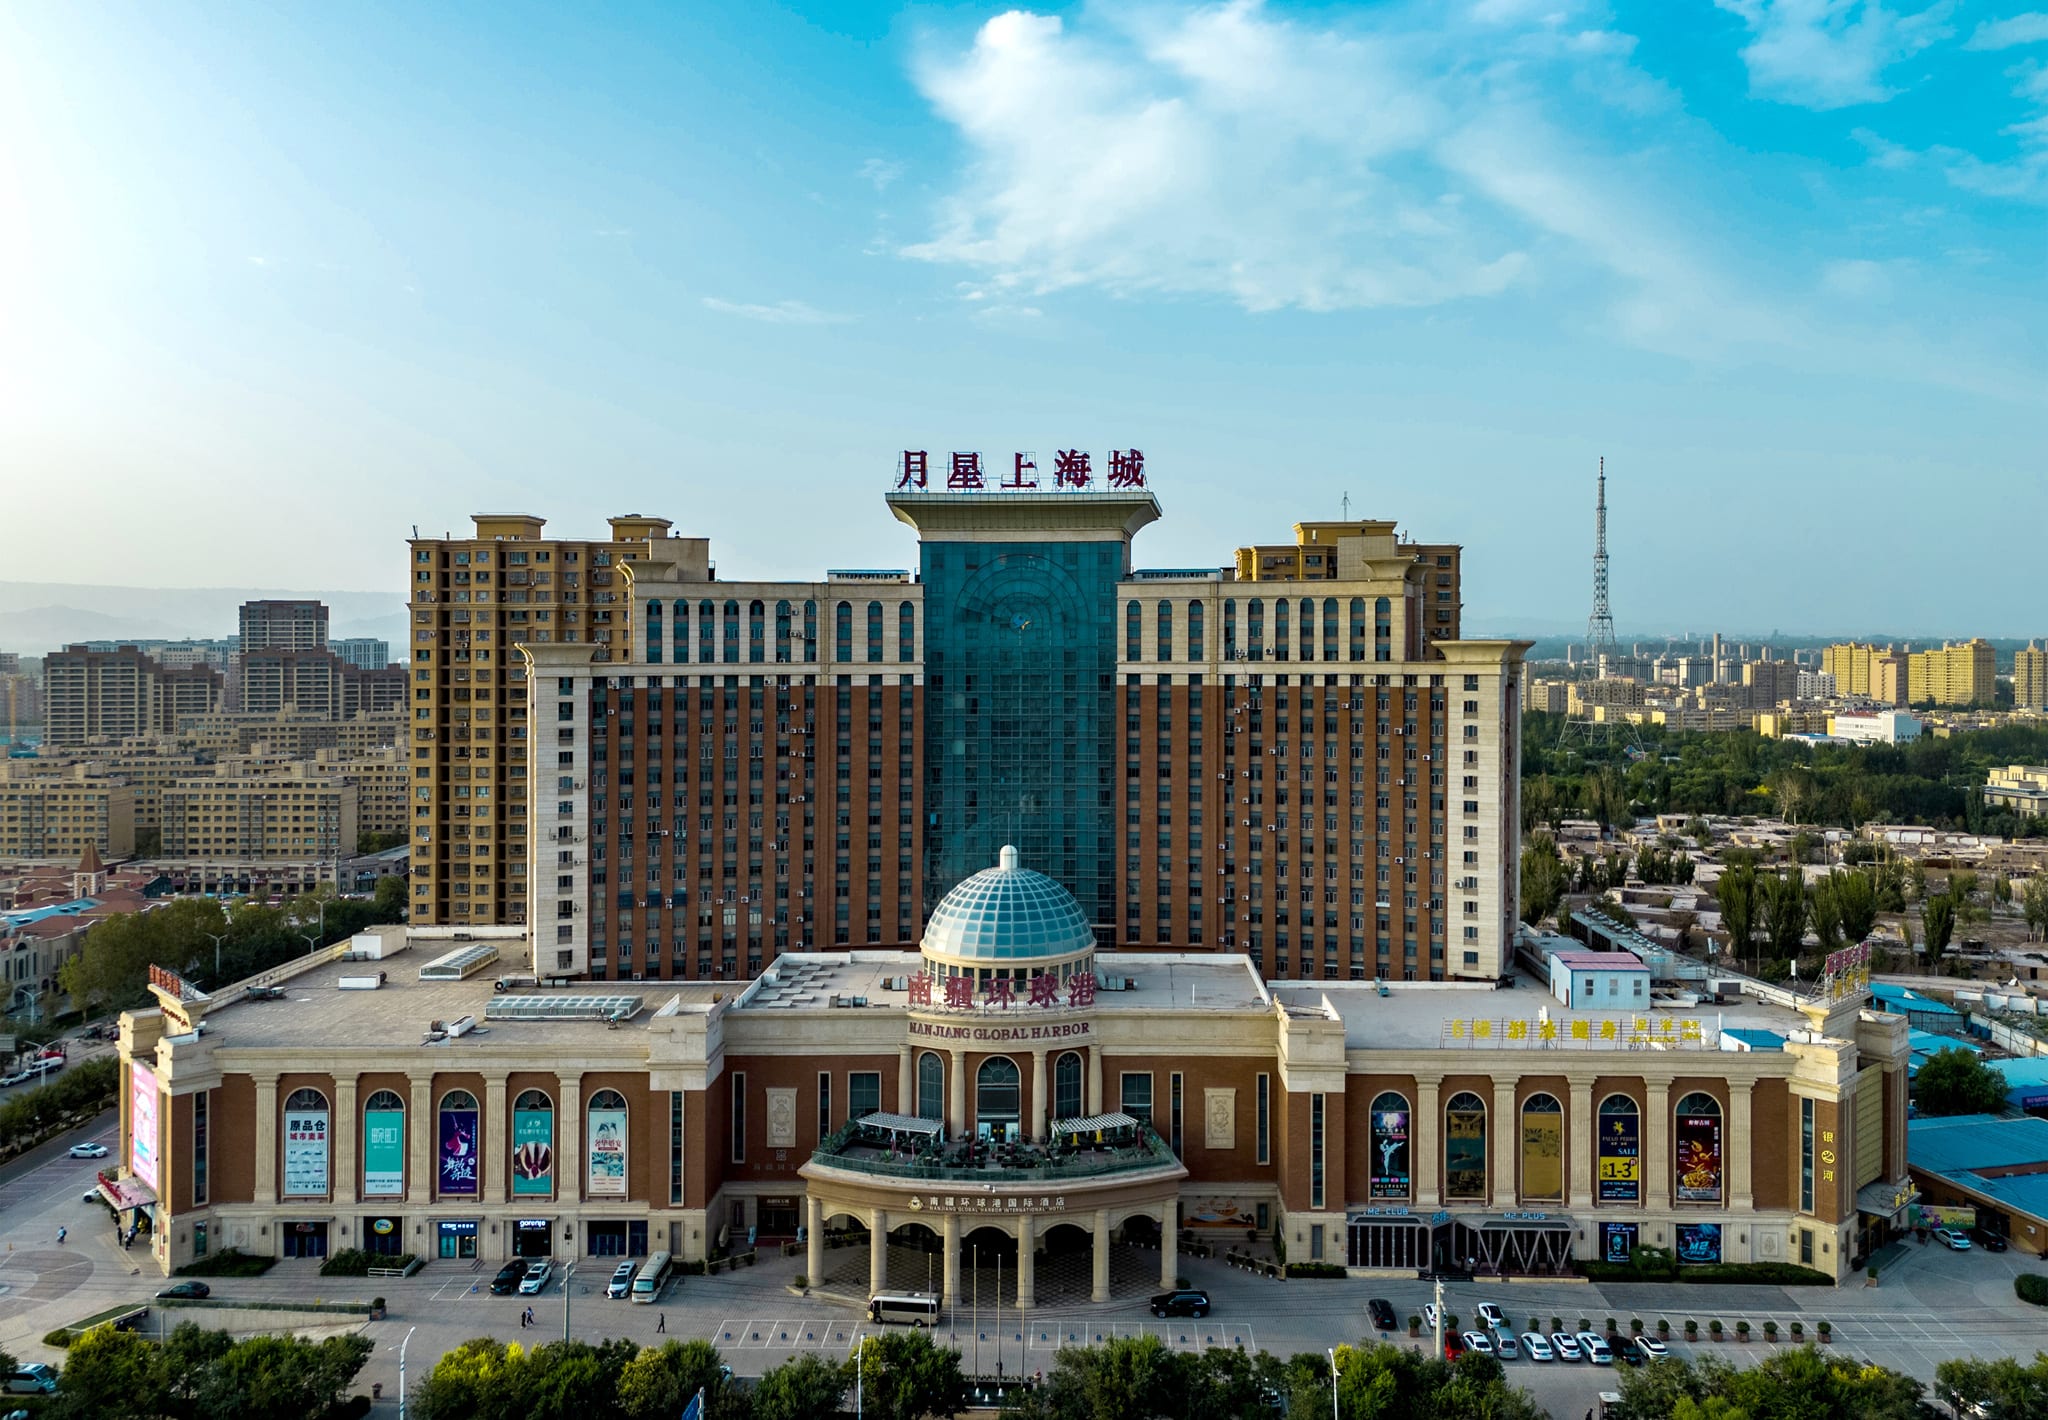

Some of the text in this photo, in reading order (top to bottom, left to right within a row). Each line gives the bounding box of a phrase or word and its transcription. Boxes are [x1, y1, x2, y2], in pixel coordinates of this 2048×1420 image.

[897, 448, 1145, 488] 月星上海城
[907, 970, 1097, 1010] 南疆环球港
[909, 1022, 1090, 1041] NANJIANG GLOBAL HARBOR
[290, 1119, 326, 1132] 原品仓
[1608, 1162, 1632, 1178] 1-3
[929, 1196, 1065, 1208] 南疆环球港国际酒店
[1386, 1208, 1409, 1216] CLUB
[1503, 1212, 1546, 1220] M2 PLUS
[519, 1220, 546, 1228] gorenje
